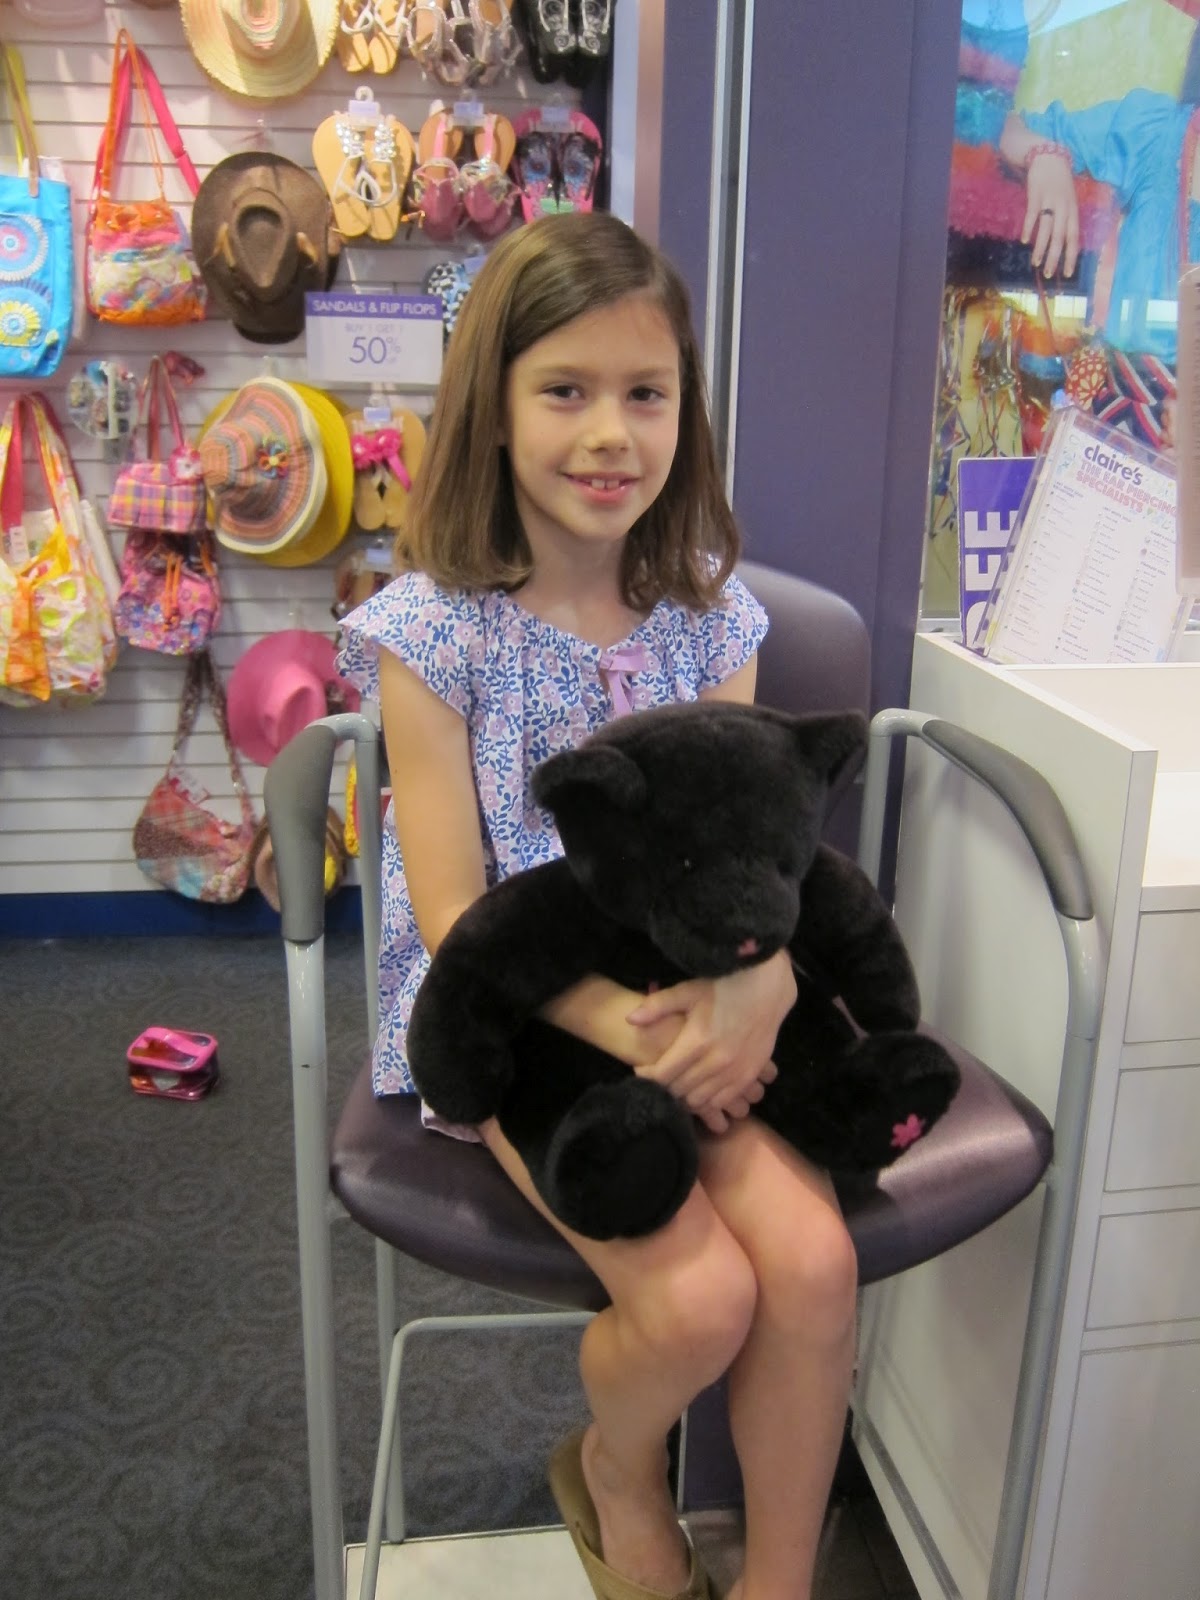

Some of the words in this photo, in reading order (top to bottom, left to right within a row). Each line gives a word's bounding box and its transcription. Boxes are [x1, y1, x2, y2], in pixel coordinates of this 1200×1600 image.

[313, 300, 366, 313] SANDALS
[368, 302, 378, 313] &
[380, 302, 401, 314] FLIP
[403, 303, 437, 315] FLOPS
[1080, 460, 1103, 477] THE
[1103, 470, 1126, 491] EAR
[1084, 445, 1143, 486] claire's
[1076, 470, 1144, 513] SPECIALISTS
